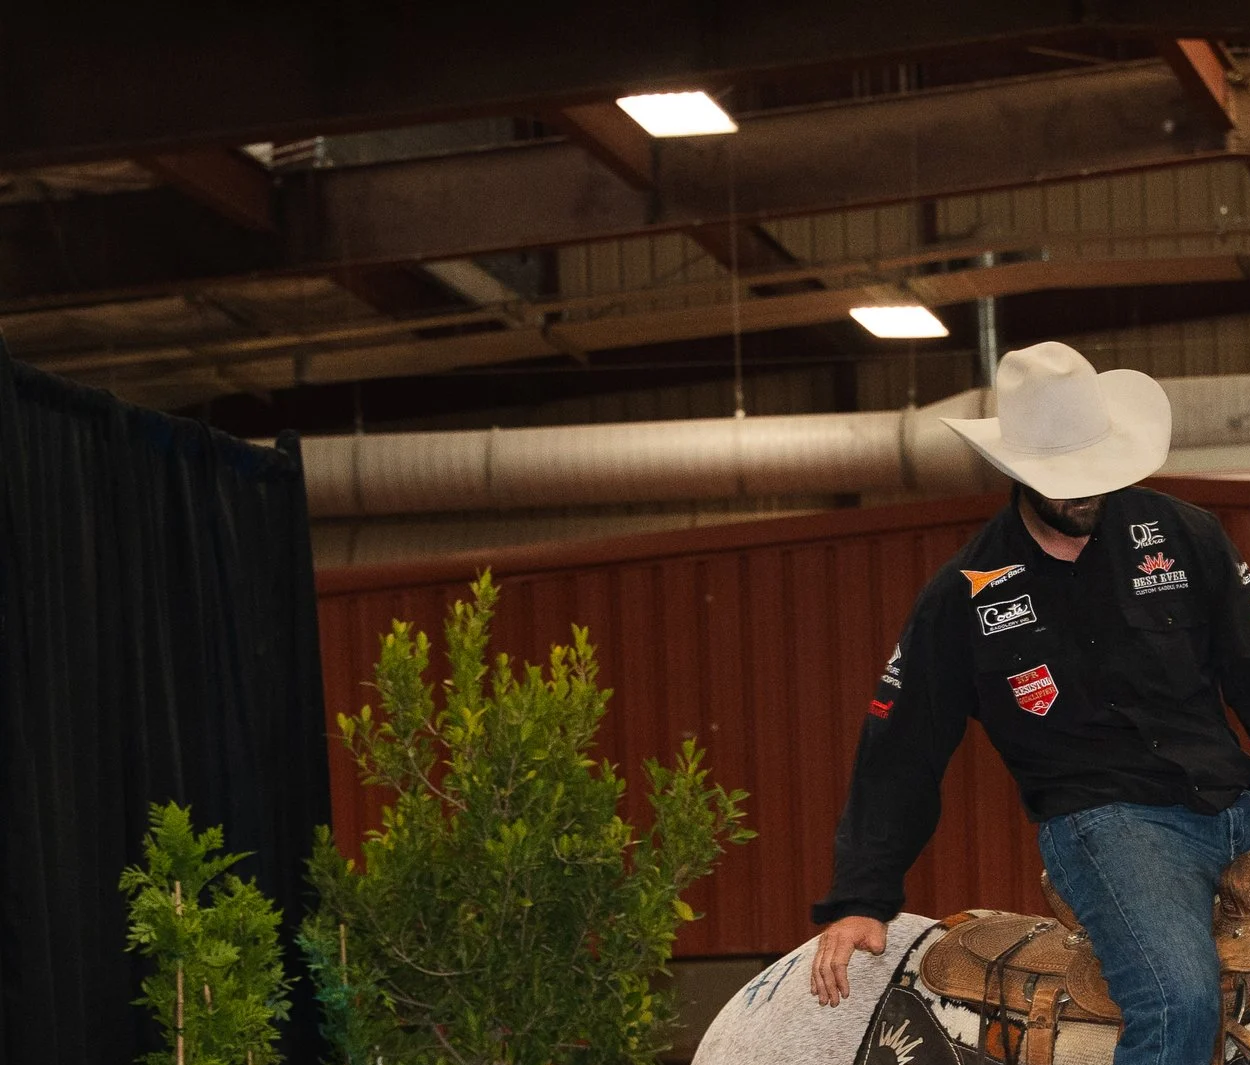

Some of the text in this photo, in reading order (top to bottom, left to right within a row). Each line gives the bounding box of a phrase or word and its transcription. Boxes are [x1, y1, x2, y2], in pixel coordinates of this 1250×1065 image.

[990, 566, 1026, 587] Fast Back
[1133, 570, 1187, 588] BEST EVER
[1135, 587, 1157, 596] CUSTOM
[984, 603, 1031, 626] Coats
